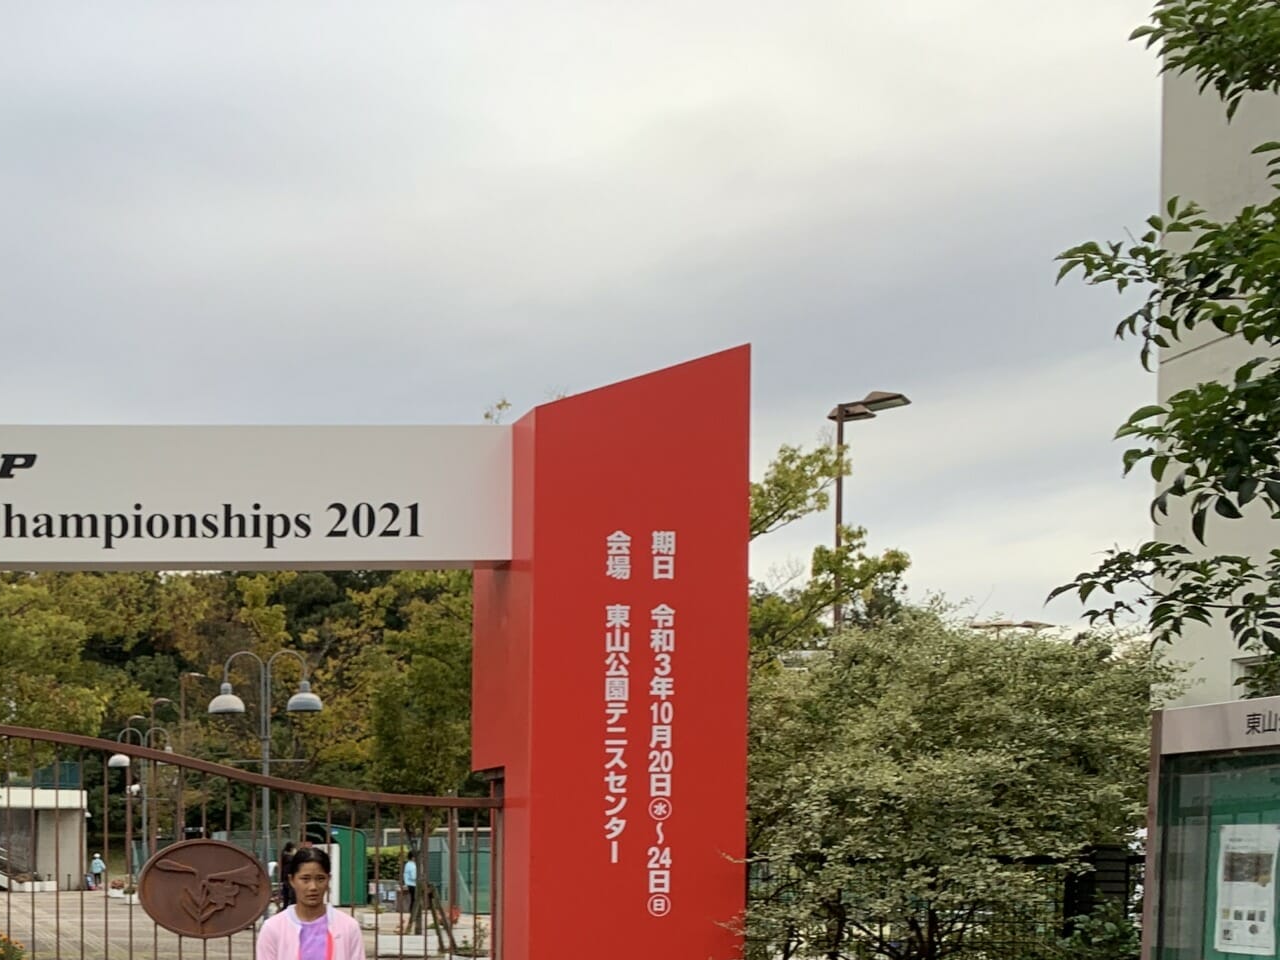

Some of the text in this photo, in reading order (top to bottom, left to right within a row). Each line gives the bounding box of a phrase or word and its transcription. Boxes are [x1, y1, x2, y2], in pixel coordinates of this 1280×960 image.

[327, 503, 420, 538] 2021
[650, 530, 677, 580] 期日
[604, 530, 632, 864] 会場 東山公園テニスセンター
[1246, 710, 1280, 736] 東山
